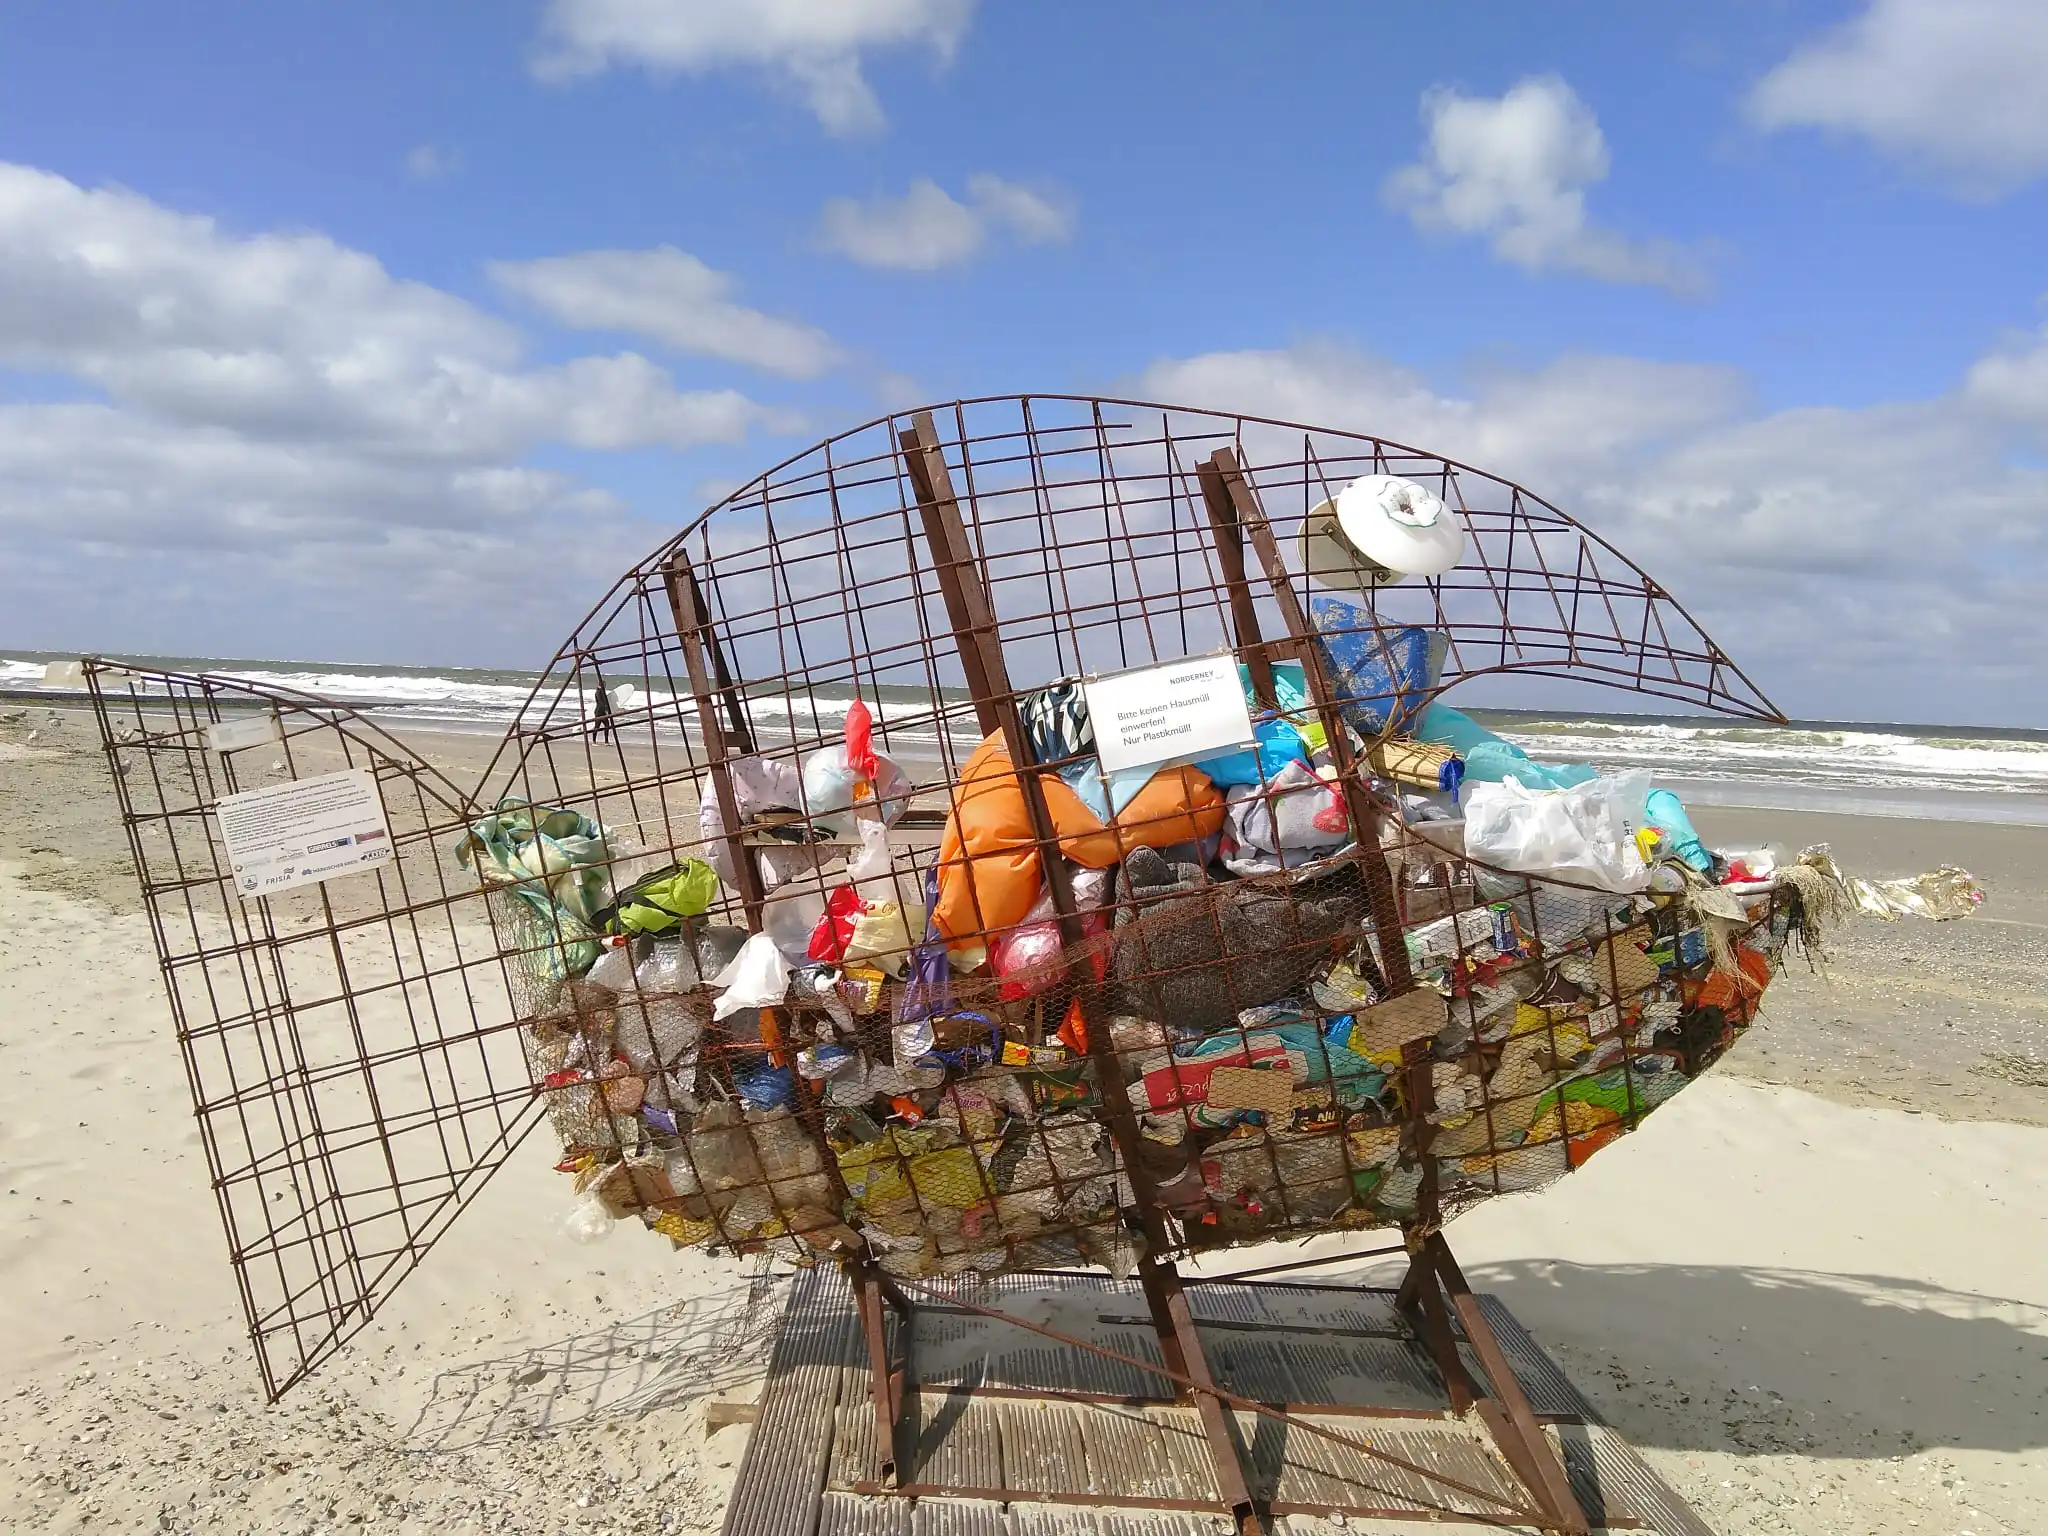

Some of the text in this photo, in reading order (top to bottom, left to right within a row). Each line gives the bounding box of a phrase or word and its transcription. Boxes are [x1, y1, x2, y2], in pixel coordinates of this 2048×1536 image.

[1169, 670, 1214, 686] NORDERNEY
[1117, 693, 1210, 721] Bitte keinen Hausmüll
[1120, 717, 1166, 733] einwerfen!
[1123, 723, 1192, 746] Nur Plastikmüll!
[265, 873, 291, 885] FRISIA
